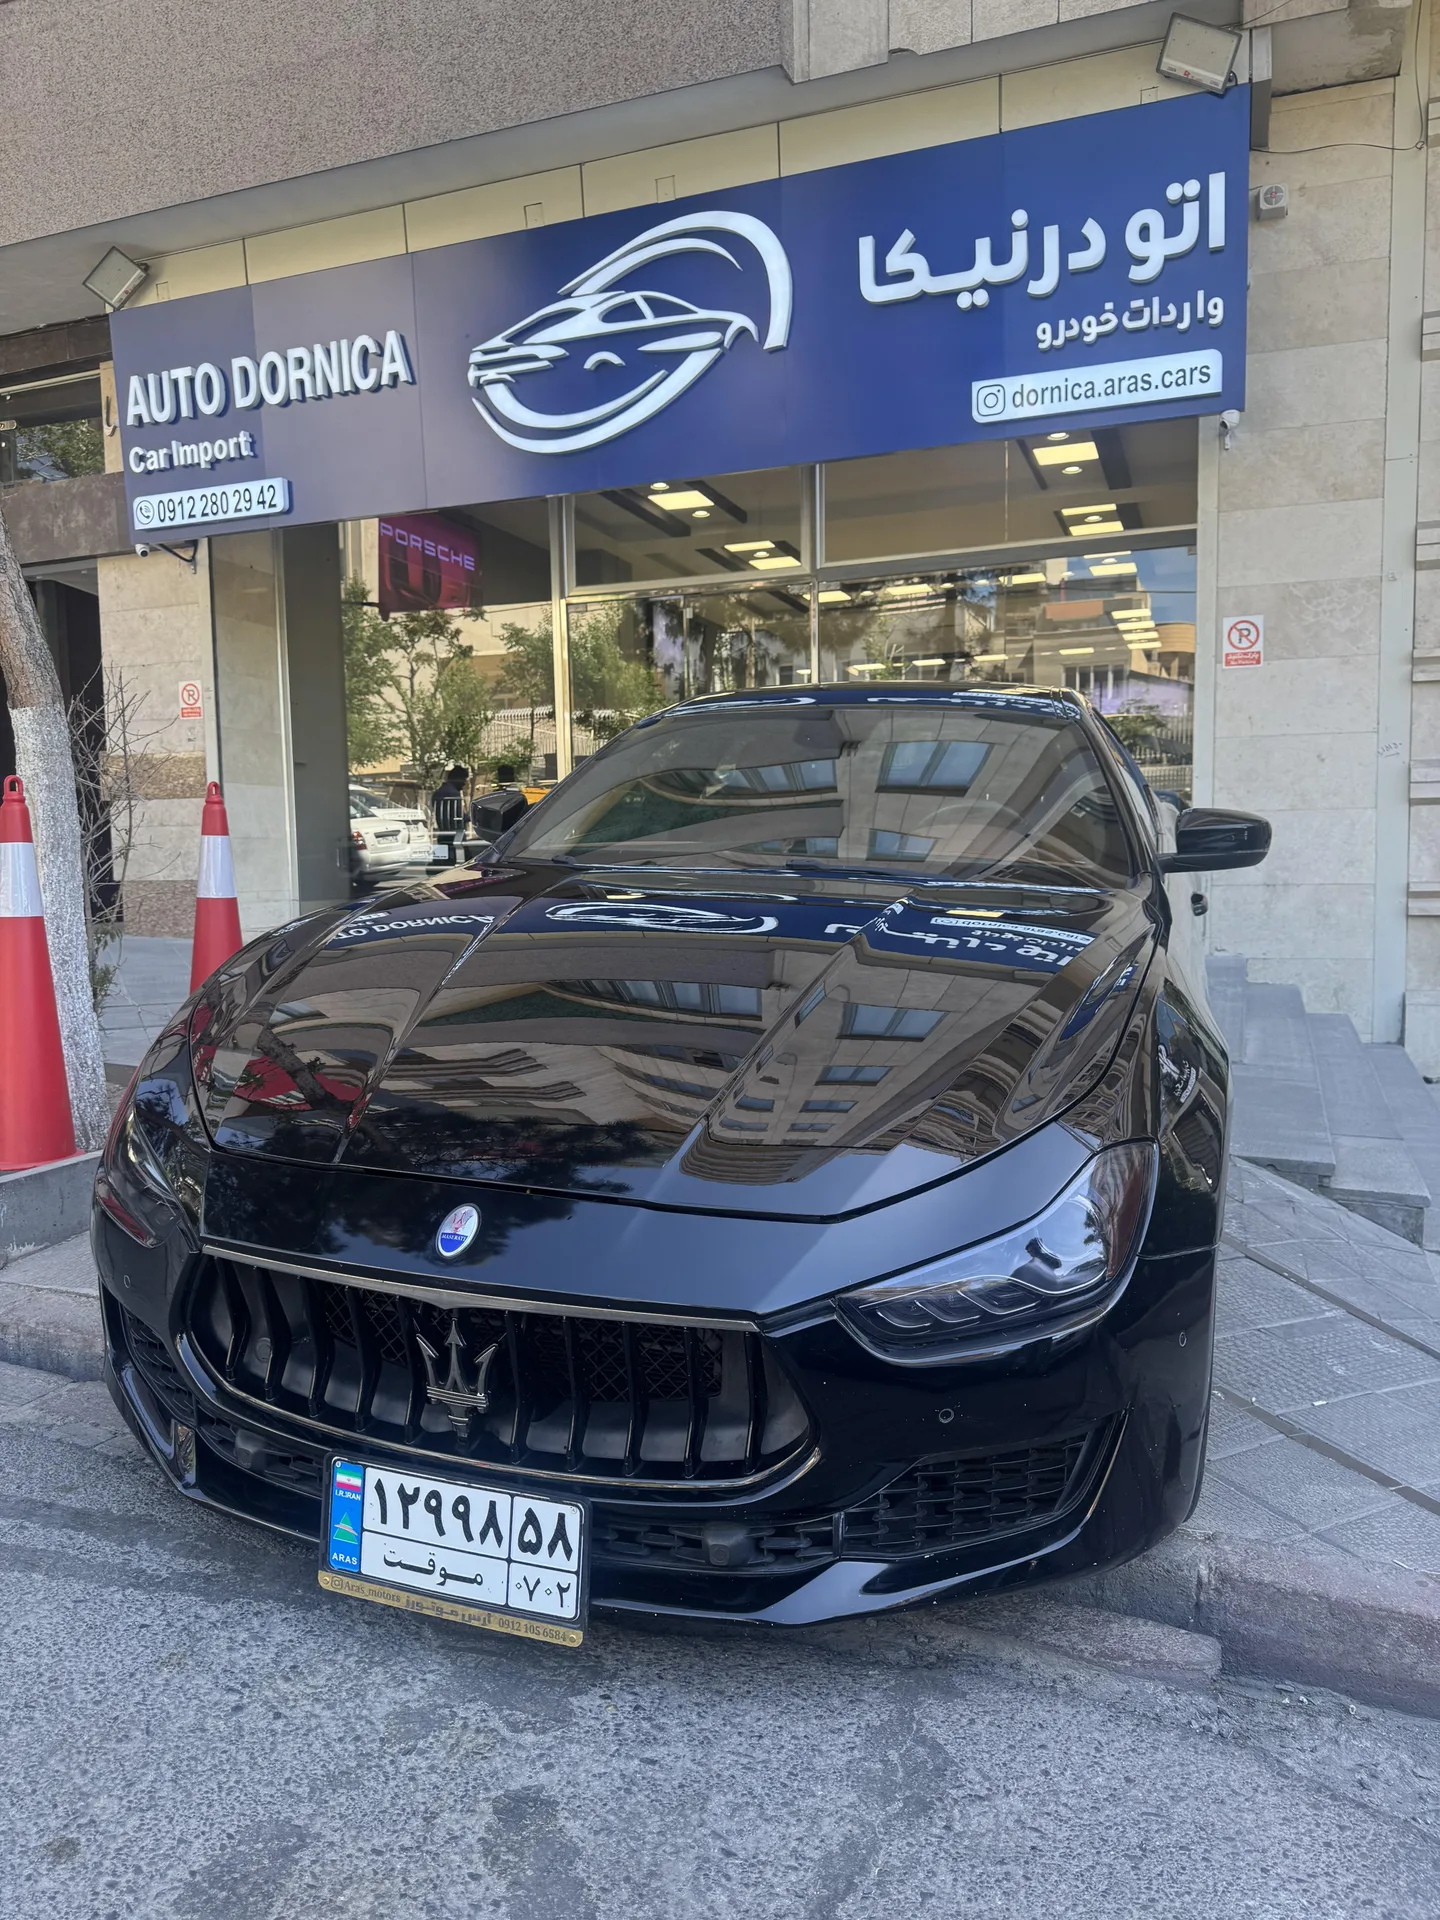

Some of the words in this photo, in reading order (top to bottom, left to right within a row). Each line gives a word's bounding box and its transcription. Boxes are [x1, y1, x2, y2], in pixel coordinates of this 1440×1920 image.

[1125, 171, 1225, 283] اتو
[858, 208, 1107, 310] درنیکا
[1036, 302, 1119, 351] خودرو
[1122, 290, 1224, 331] واردات
[127, 362, 227, 426] AUTO
[231, 330, 414, 409] DORNICA
[1011, 361, 1212, 409] dornica.aras.cars
[129, 446, 168, 473] Car
[171, 430, 253, 468] Import
[157, 495, 196, 523] 0912
[200, 491, 229, 517] 280
[232, 488, 253, 513] 29
[256, 485, 278, 510] 42
[380, 522, 475, 571] PORSCHE
[374, 1478, 504, 1548] ۱۲۹۹۸
[517, 1507, 574, 1562] ۵۸
[332, 1552, 358, 1565] ARAS
[383, 1550, 484, 1587] موقت
[498, 1617, 522, 1632] 0912
